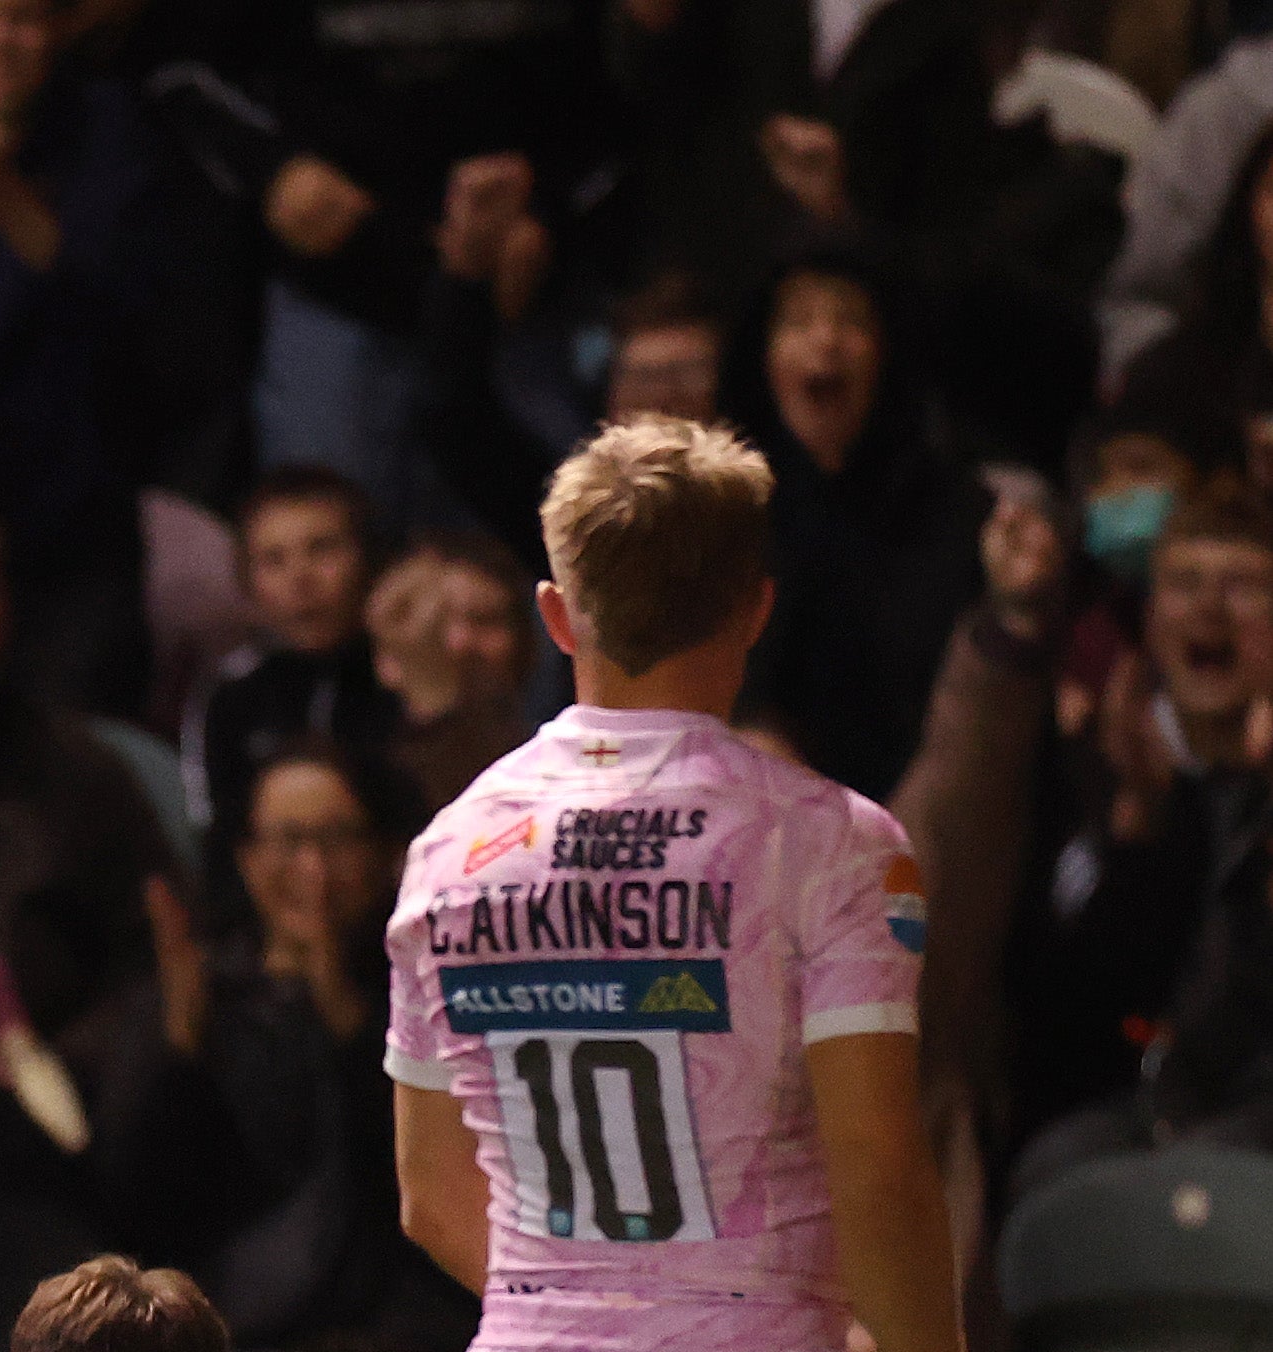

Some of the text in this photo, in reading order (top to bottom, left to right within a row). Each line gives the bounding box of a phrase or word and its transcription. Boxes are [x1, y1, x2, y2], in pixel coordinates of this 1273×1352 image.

[555, 808, 707, 838] CRUCIALS
[551, 838, 667, 870] SAUCES
[449, 983, 626, 1014] ALLSTONE
[516, 1039, 685, 1241] 10
